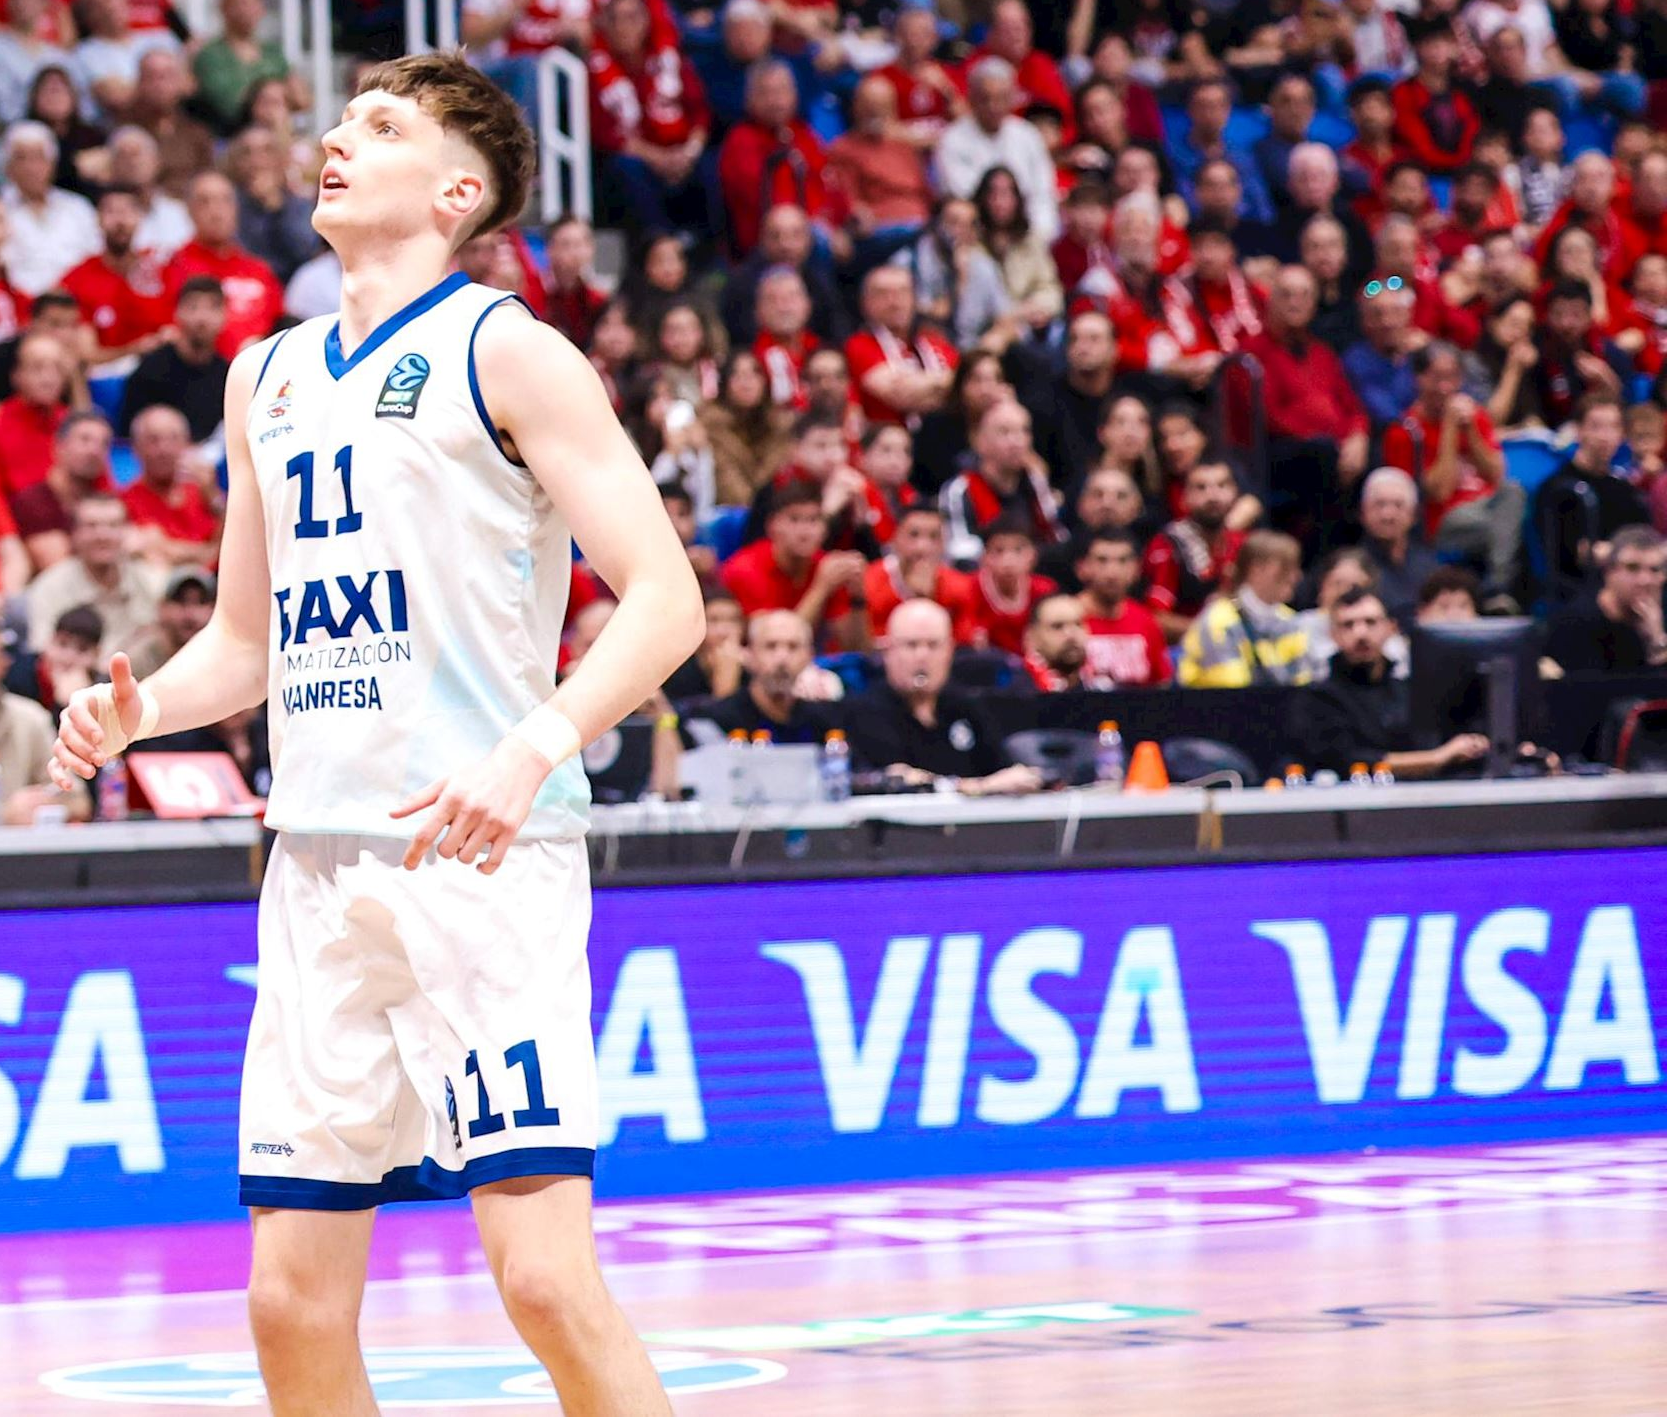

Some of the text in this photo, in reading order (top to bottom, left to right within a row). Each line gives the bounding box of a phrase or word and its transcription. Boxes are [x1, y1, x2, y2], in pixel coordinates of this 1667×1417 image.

[286, 444, 363, 541] 11
[759, 925, 1204, 1134] VISA
[1250, 904, 1662, 1105] VISA
[465, 1039, 561, 1139] 11
